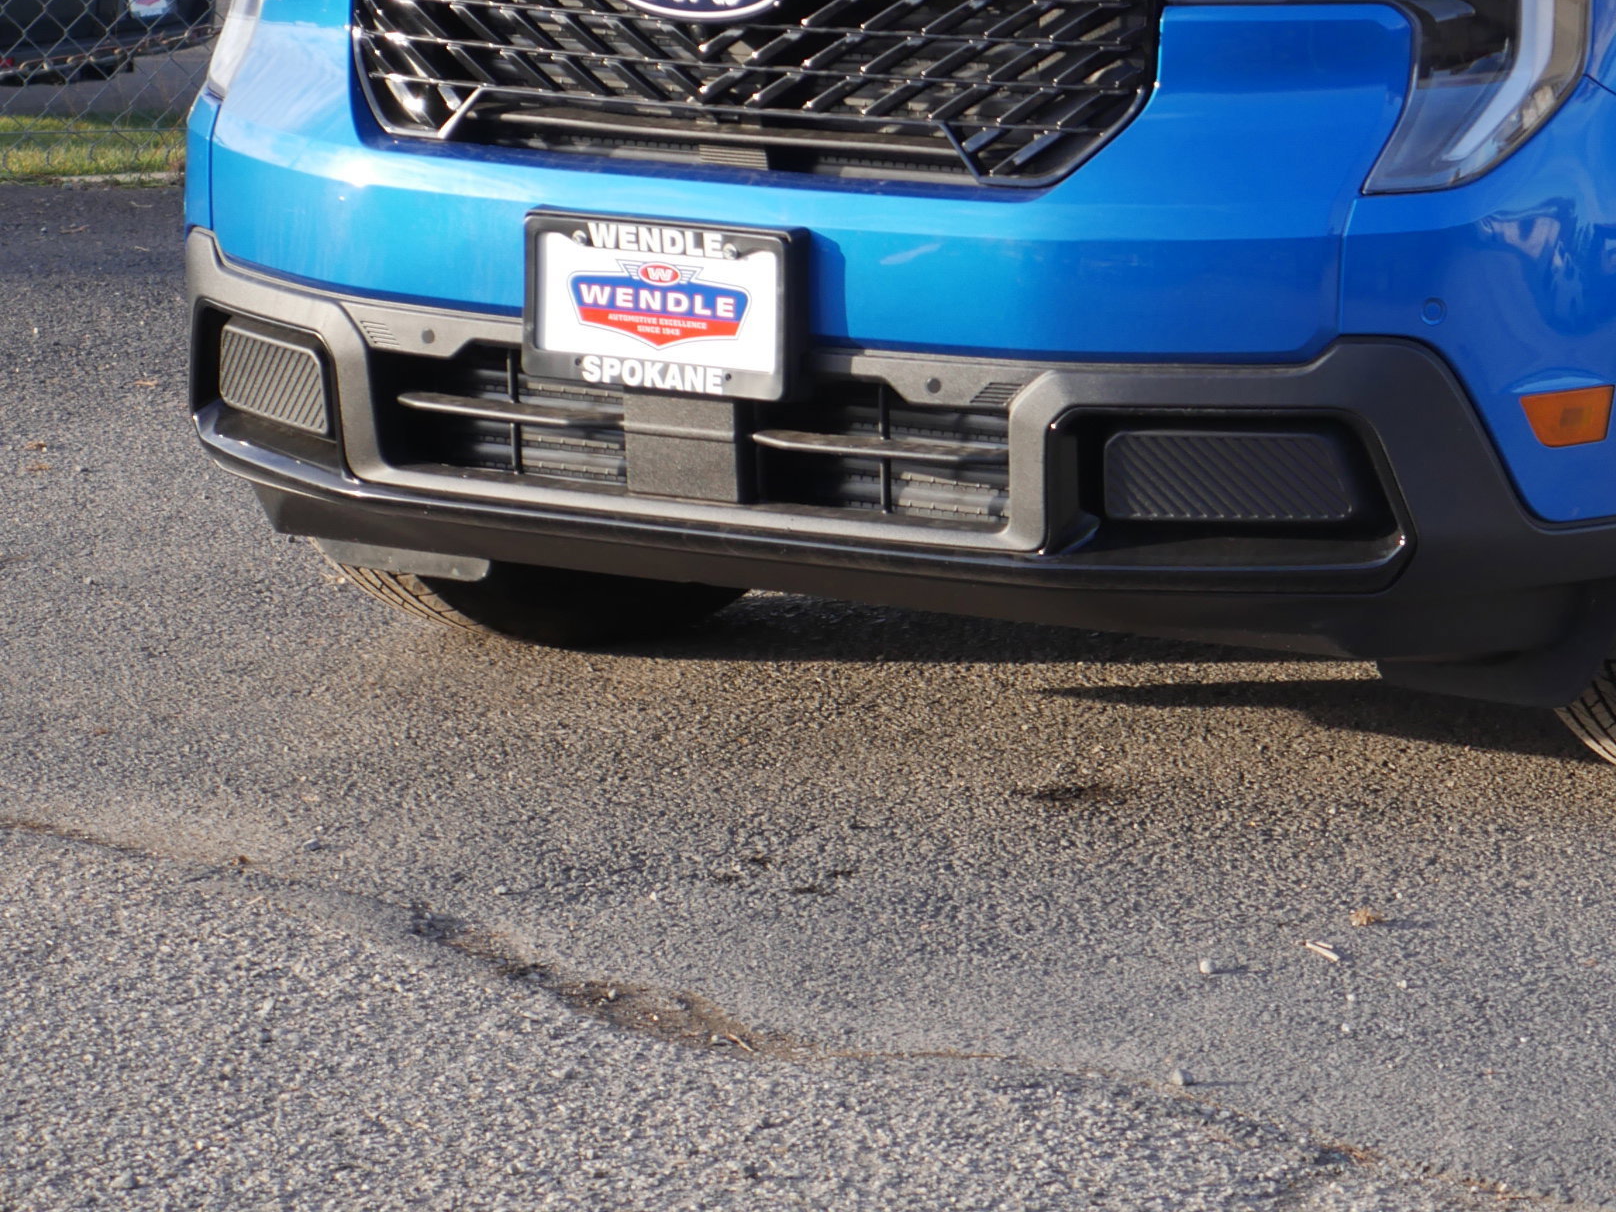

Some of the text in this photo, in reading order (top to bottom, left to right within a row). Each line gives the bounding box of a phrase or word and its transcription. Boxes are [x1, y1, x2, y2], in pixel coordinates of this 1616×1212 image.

[587, 222, 723, 258] WENDLE
[579, 283, 735, 318] WENDLE
[608, 313, 708, 329] AUTOMOTIVE EXCELLENCE
[637, 325, 661, 334] SINCE
[582, 355, 723, 394] SPOKANE
